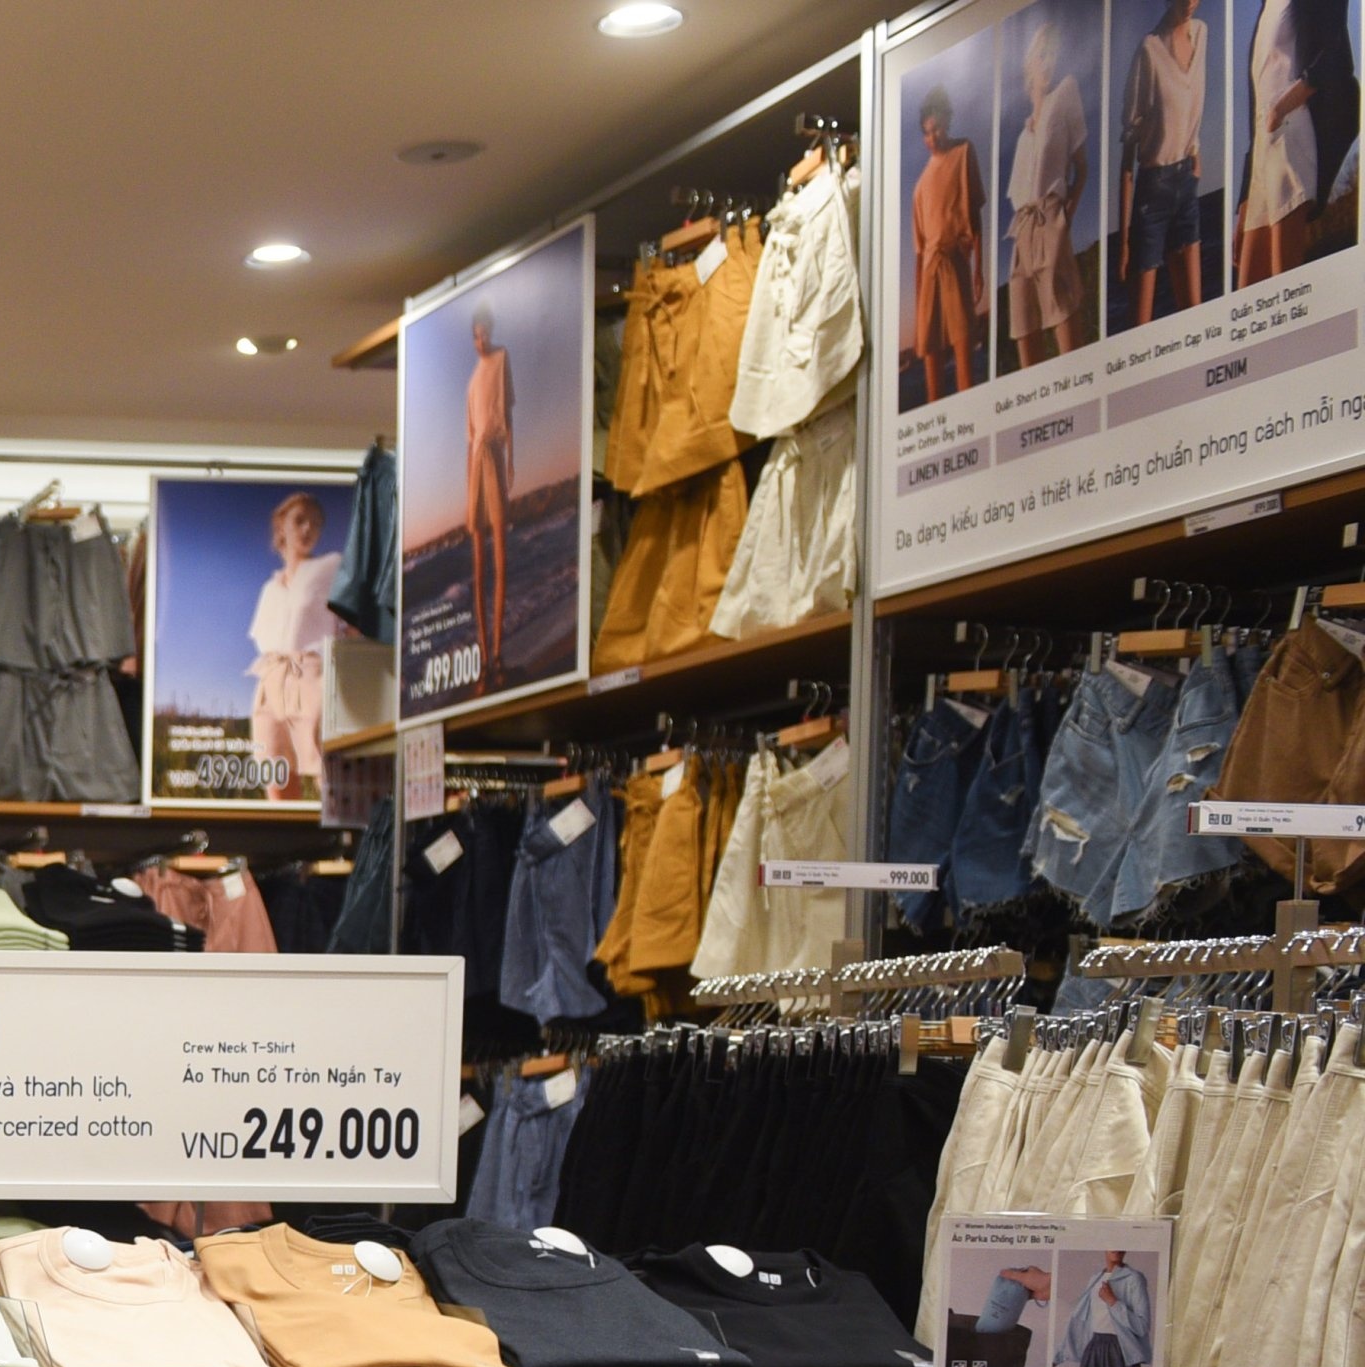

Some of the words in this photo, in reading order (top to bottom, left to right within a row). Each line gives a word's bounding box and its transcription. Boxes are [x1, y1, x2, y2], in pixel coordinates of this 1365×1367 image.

[1206, 358, 1247, 387] DENIM
[1021, 416, 1073, 448] STRETCH
[897, 530, 912, 550] Đa
[917, 522, 946, 544] dạng
[983, 502, 1015, 524] dáng
[1021, 491, 1035, 512] và
[1104, 463, 1140, 488] nâng
[1199, 430, 1247, 466] phong
[1255, 412, 1294, 443] cách
[1341, 394, 1365, 420] ng
[909, 463, 939, 485] LINEN
[943, 448, 979, 474] BLEND
[889, 871, 929, 885] 999.000
[183, 1041, 214, 1053] Crew
[218, 1042, 247, 1054] Neck
[252, 1042, 295, 1054] T-Shirt
[25, 1076, 83, 1097] thanh
[93, 1076, 131, 1102] lịch,
[183, 1064, 203, 1083] Áo
[211, 1068, 249, 1083] Thun
[257, 1065, 277, 1083] Cổ
[284, 1068, 320, 1083] Tròn
[327, 1066, 366, 1088] Ngắn
[373, 1068, 401, 1087] Tay
[88, 1116, 153, 1136] cotton
